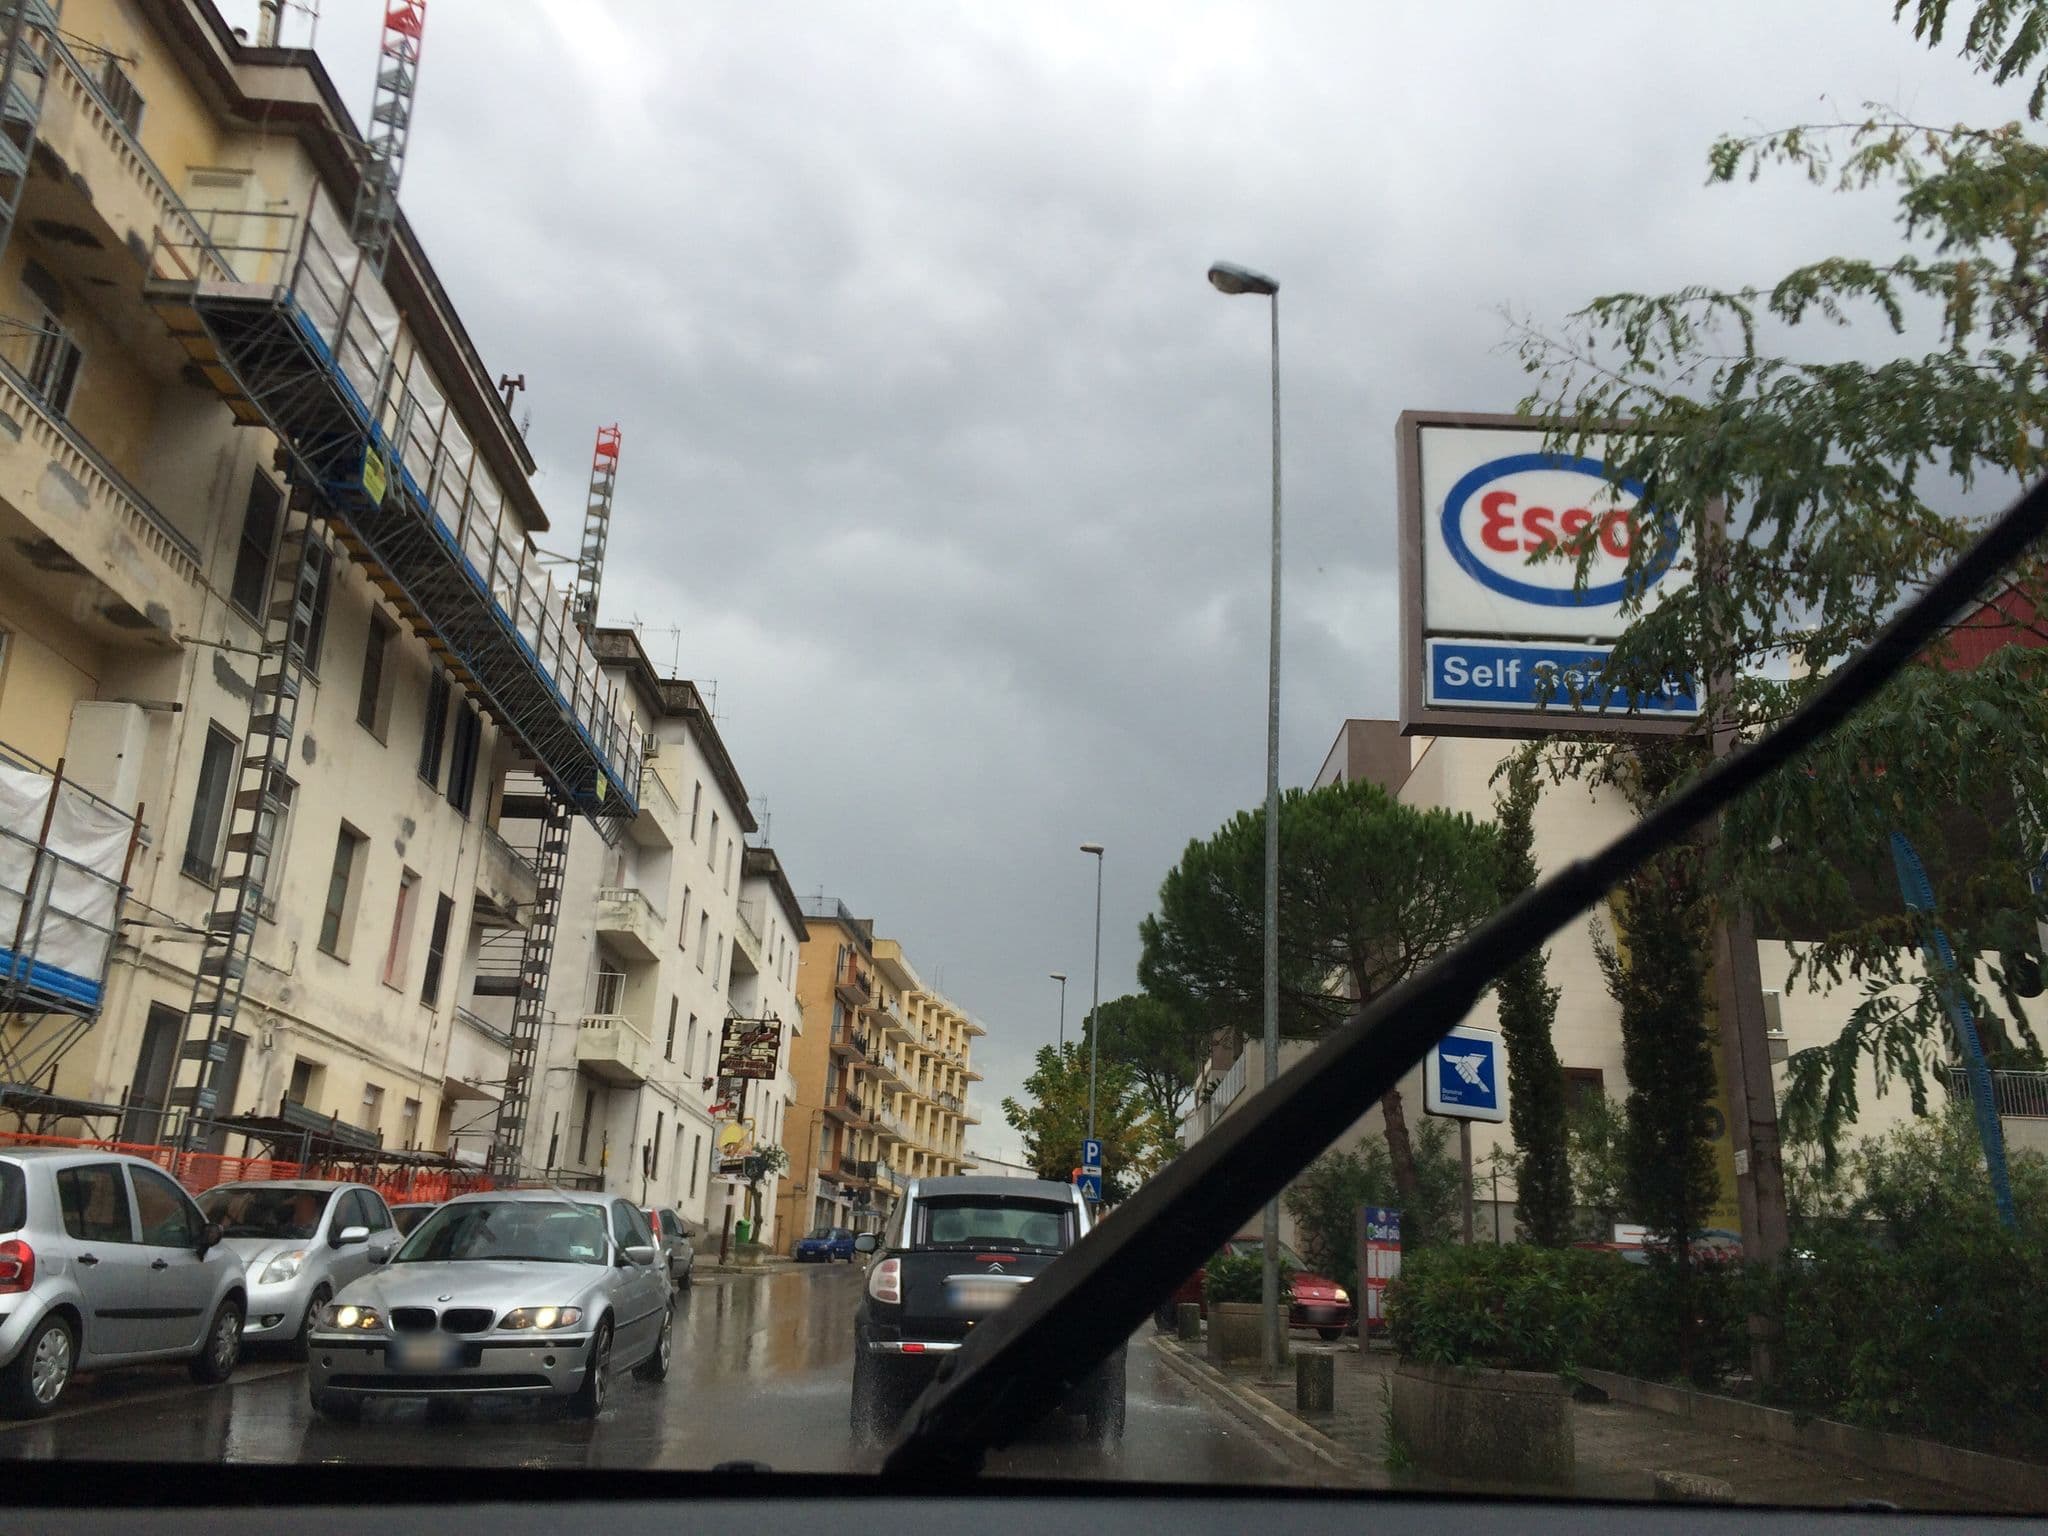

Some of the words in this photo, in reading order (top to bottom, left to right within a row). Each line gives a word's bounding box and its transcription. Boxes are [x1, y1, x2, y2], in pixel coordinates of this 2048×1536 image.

[1480, 491, 1640, 558] Esso
[1443, 656, 1520, 687] Self
[1087, 1141, 1099, 1163] P
